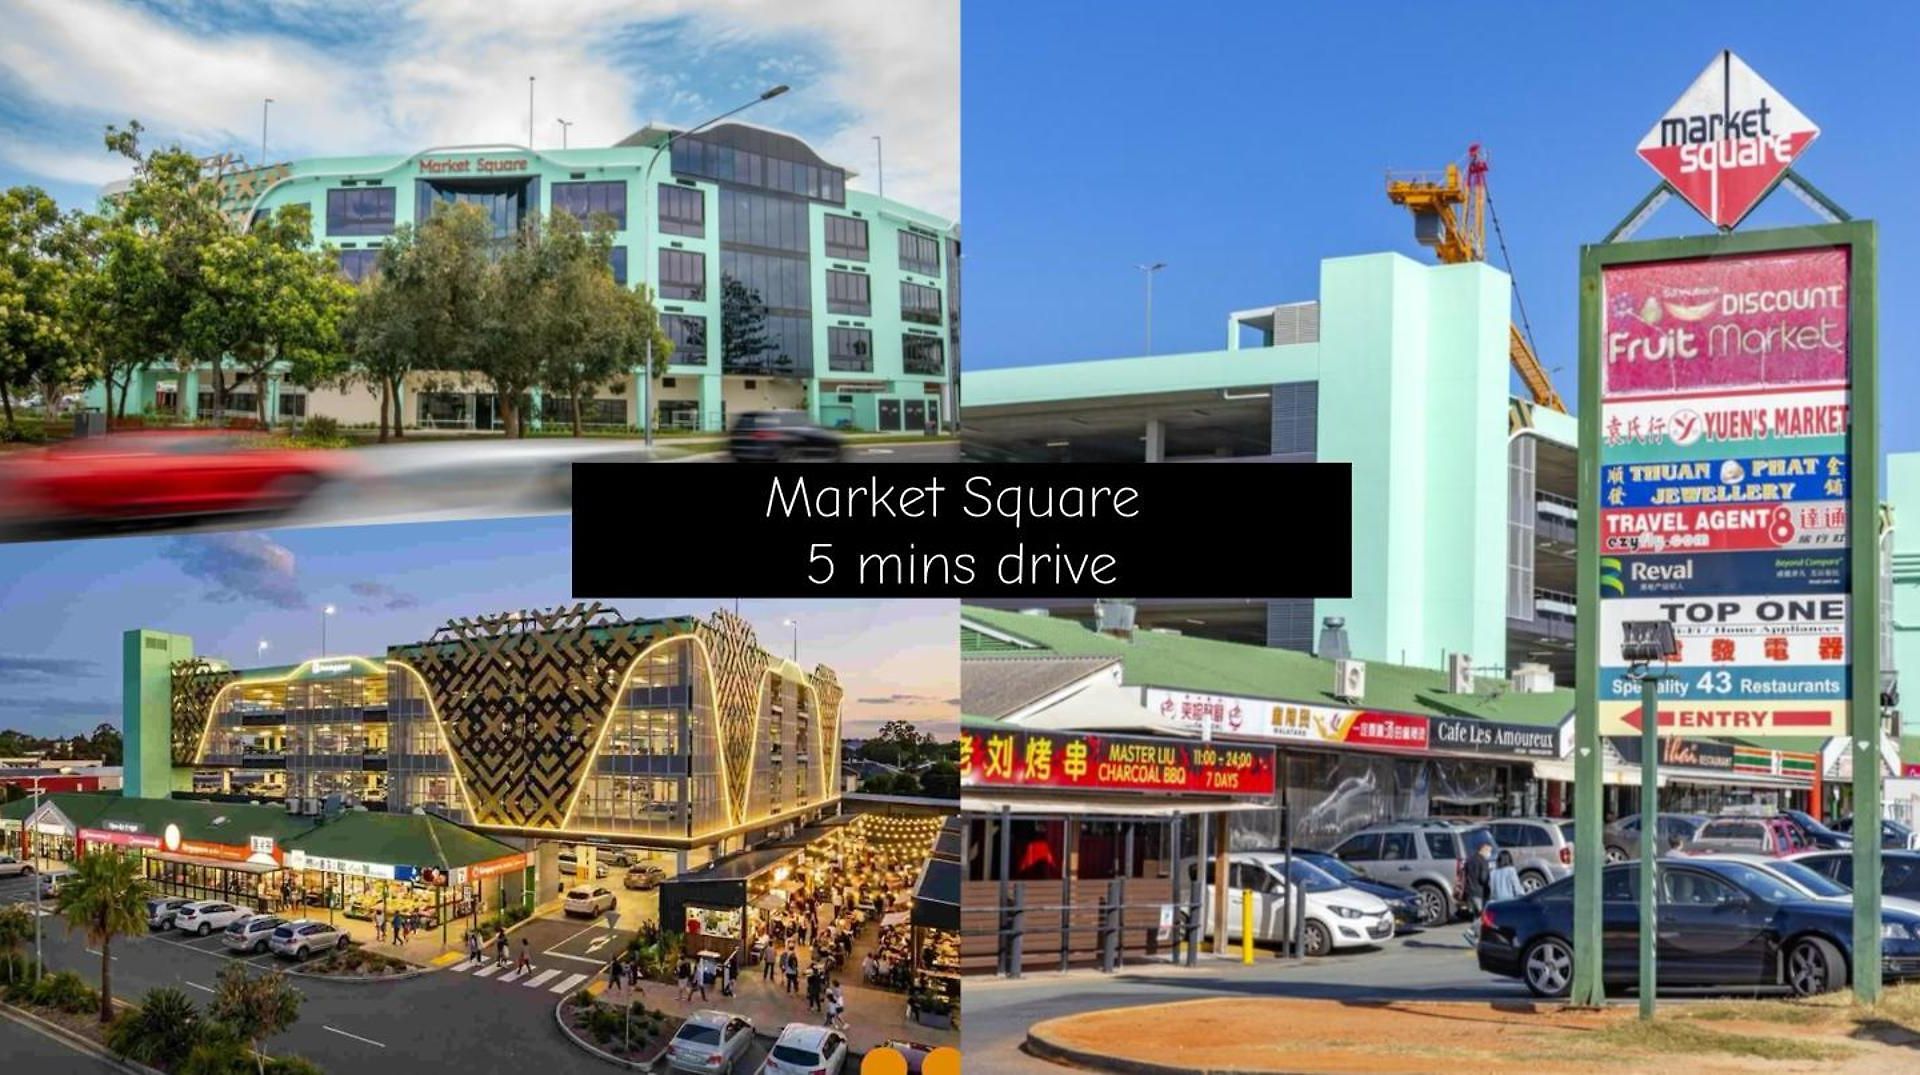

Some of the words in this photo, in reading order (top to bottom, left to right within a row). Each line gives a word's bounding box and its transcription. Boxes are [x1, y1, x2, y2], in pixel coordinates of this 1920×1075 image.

[1661, 98, 1771, 147] market
[1680, 132, 1793, 174] square
[419, 158, 470, 174] Market
[477, 157, 528, 174] Square
[1722, 285, 1843, 316] DISCOUNT
[1609, 329, 1698, 363] Fruit
[1707, 317, 1843, 355] Market
[1606, 415, 1666, 444] 袁氏行
[1704, 408, 1768, 439] YUEN'S
[1774, 404, 1849, 436] MARKET
[1630, 463, 1711, 482] THUAN
[1752, 458, 1819, 477] PHAT
[1650, 483, 1796, 504] JEWELLERY
[1606, 511, 1689, 533] TRAVEL
[1695, 509, 1770, 530] AGENT
[1631, 559, 1693, 580] Reval
[1660, 602, 1741, 623] TOP
[1756, 601, 1844, 621] ONE
[1673, 625, 1701, 634] i-Fi
[1715, 625, 1756, 634] Home
[1761, 625, 1840, 635] Appliances
[1612, 678, 1689, 697] Speality
[1696, 671, 1733, 693] 43
[1740, 678, 1841, 694] Restaurants
[1679, 711, 1768, 727] ENTRY
[1438, 722, 1467, 741] Cafe
[1470, 725, 1492, 744] Les
[1495, 729, 1553, 748] Amoureux
[1109, 744, 1156, 763] MASTER
[1099, 763, 1160, 783] CHARCOAL
[1163, 766, 1186, 784] BBQ
[1206, 771, 1213, 788] 7
[1214, 772, 1239, 789] DAYS
